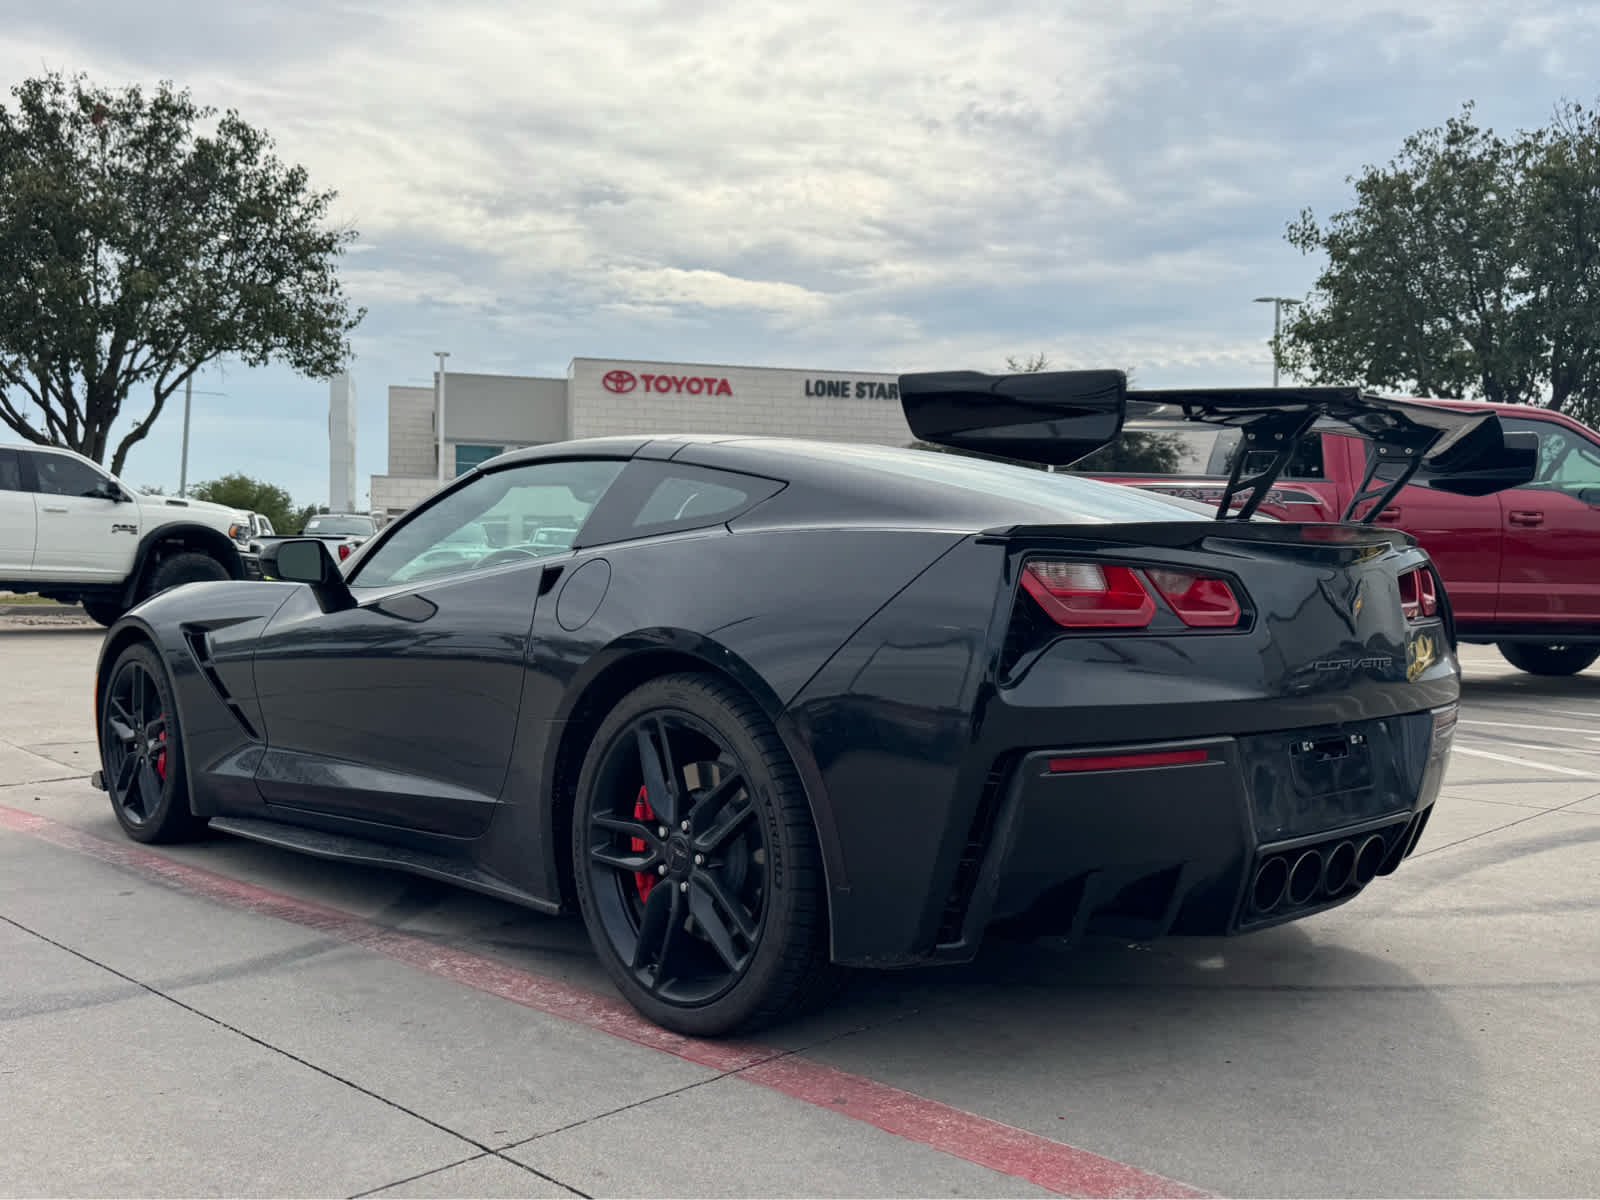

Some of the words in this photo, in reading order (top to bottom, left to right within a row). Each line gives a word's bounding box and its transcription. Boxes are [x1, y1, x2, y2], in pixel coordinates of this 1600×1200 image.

[640, 374, 733, 396] TOYOTA
[805, 379, 850, 398] LONE
[855, 382, 898, 400] STAR
[1313, 656, 1393, 672] CORVETTE
